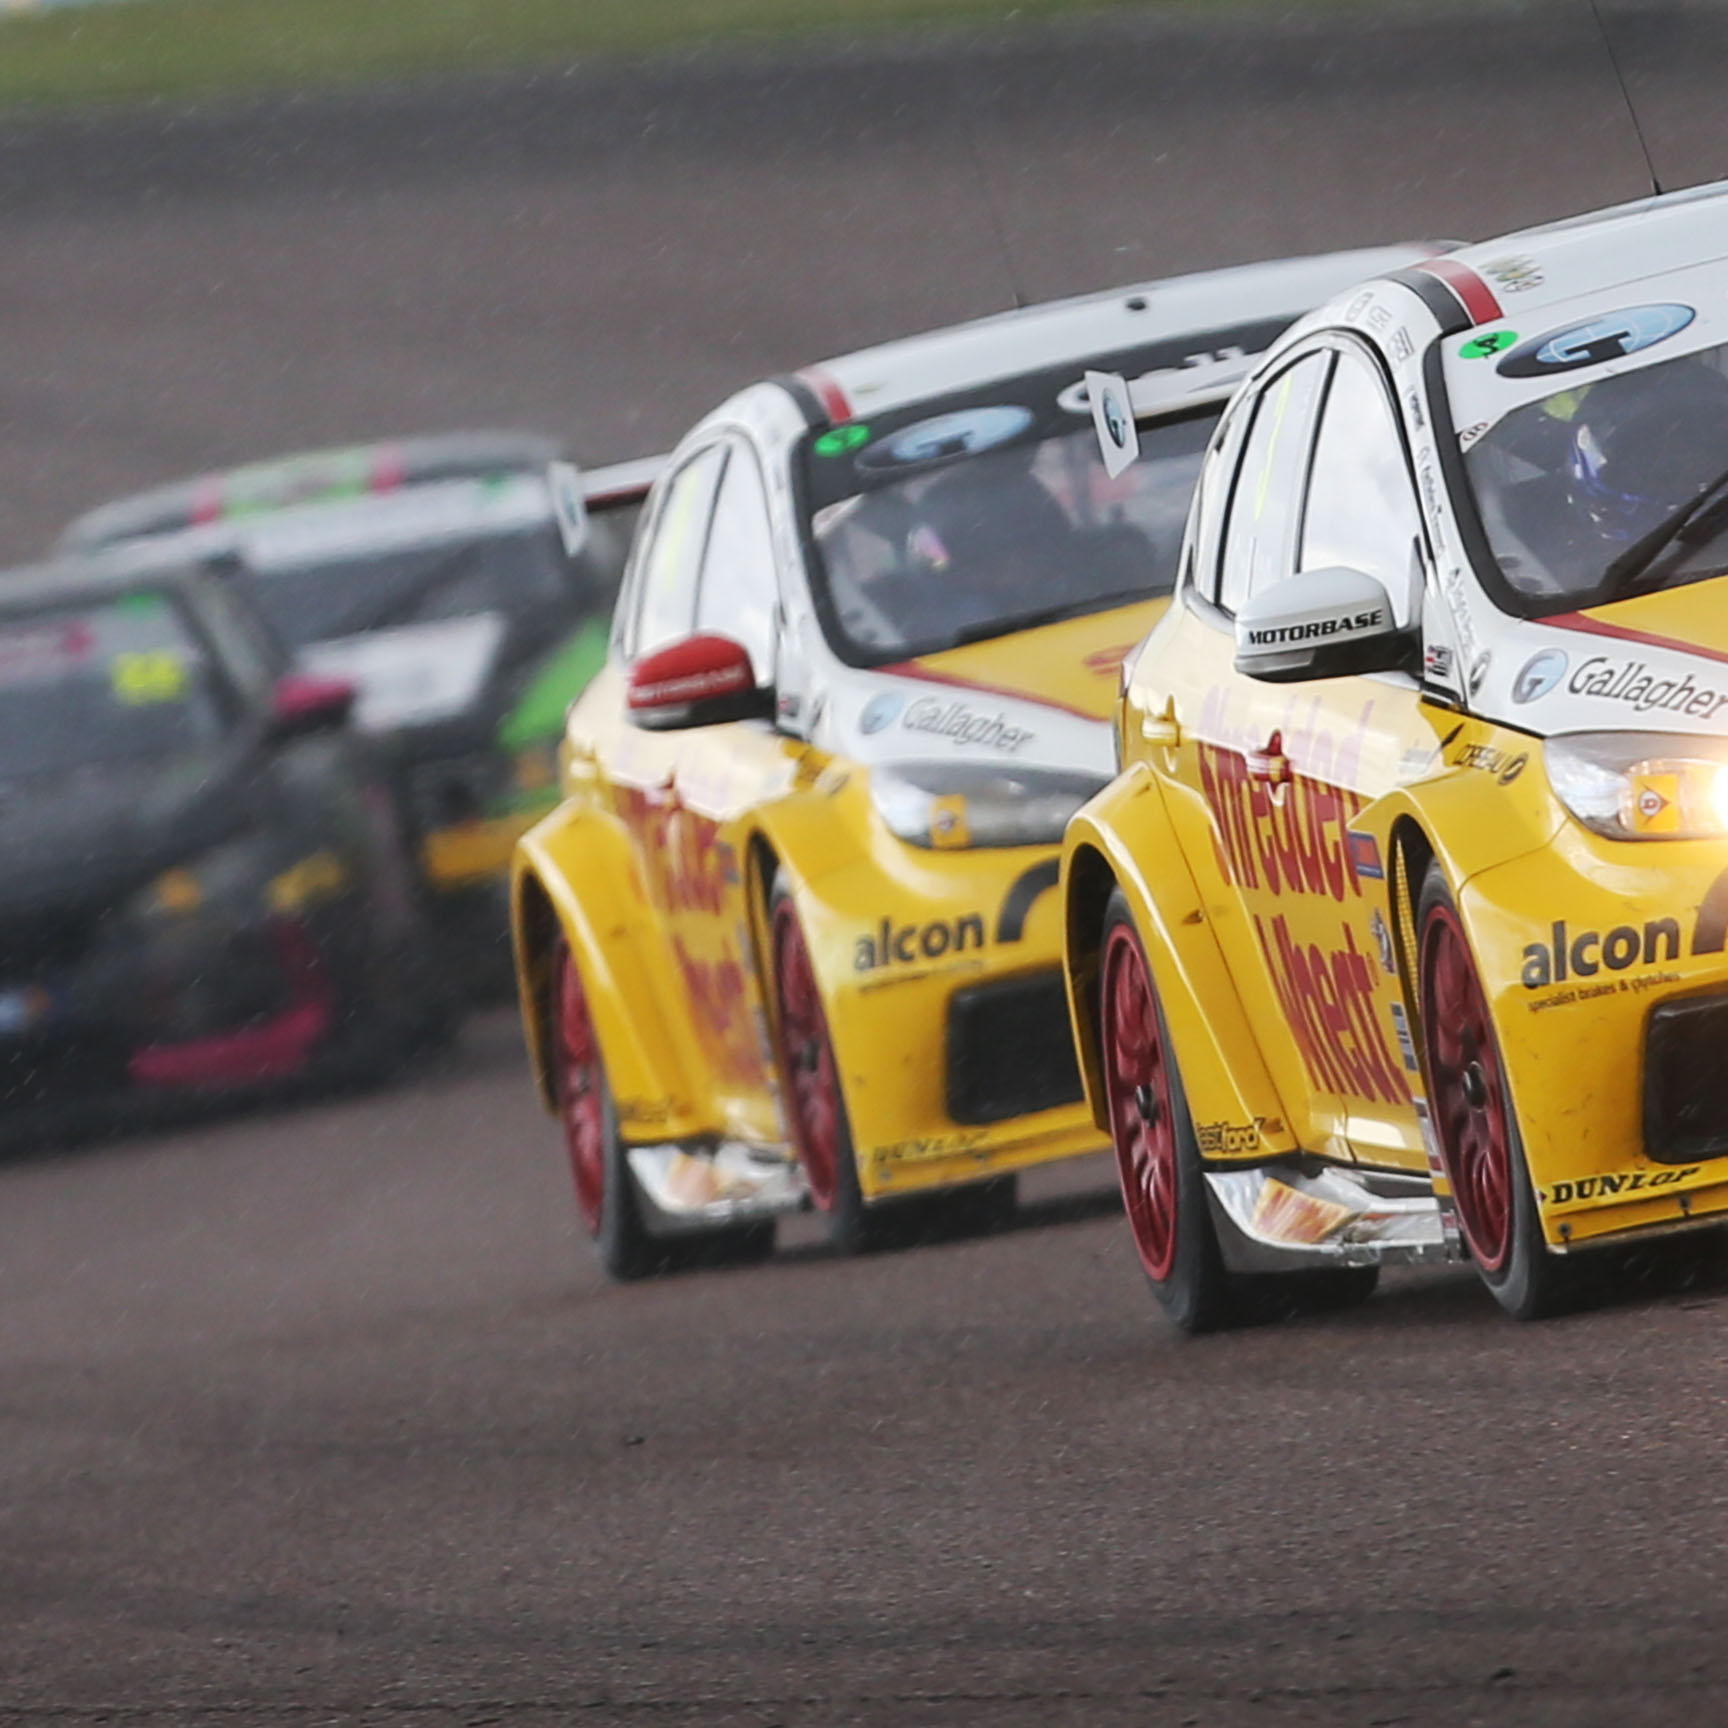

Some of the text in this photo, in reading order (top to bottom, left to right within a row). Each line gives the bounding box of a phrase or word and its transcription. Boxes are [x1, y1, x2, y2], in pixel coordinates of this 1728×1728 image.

[1248, 609, 1384, 645] MOTORBASE
[901, 696, 1036, 754] Gallagher
[854, 913, 985, 971] alcon
[1521, 917, 1680, 990] alcon
[1551, 1167, 1700, 1204] DUNLOP
